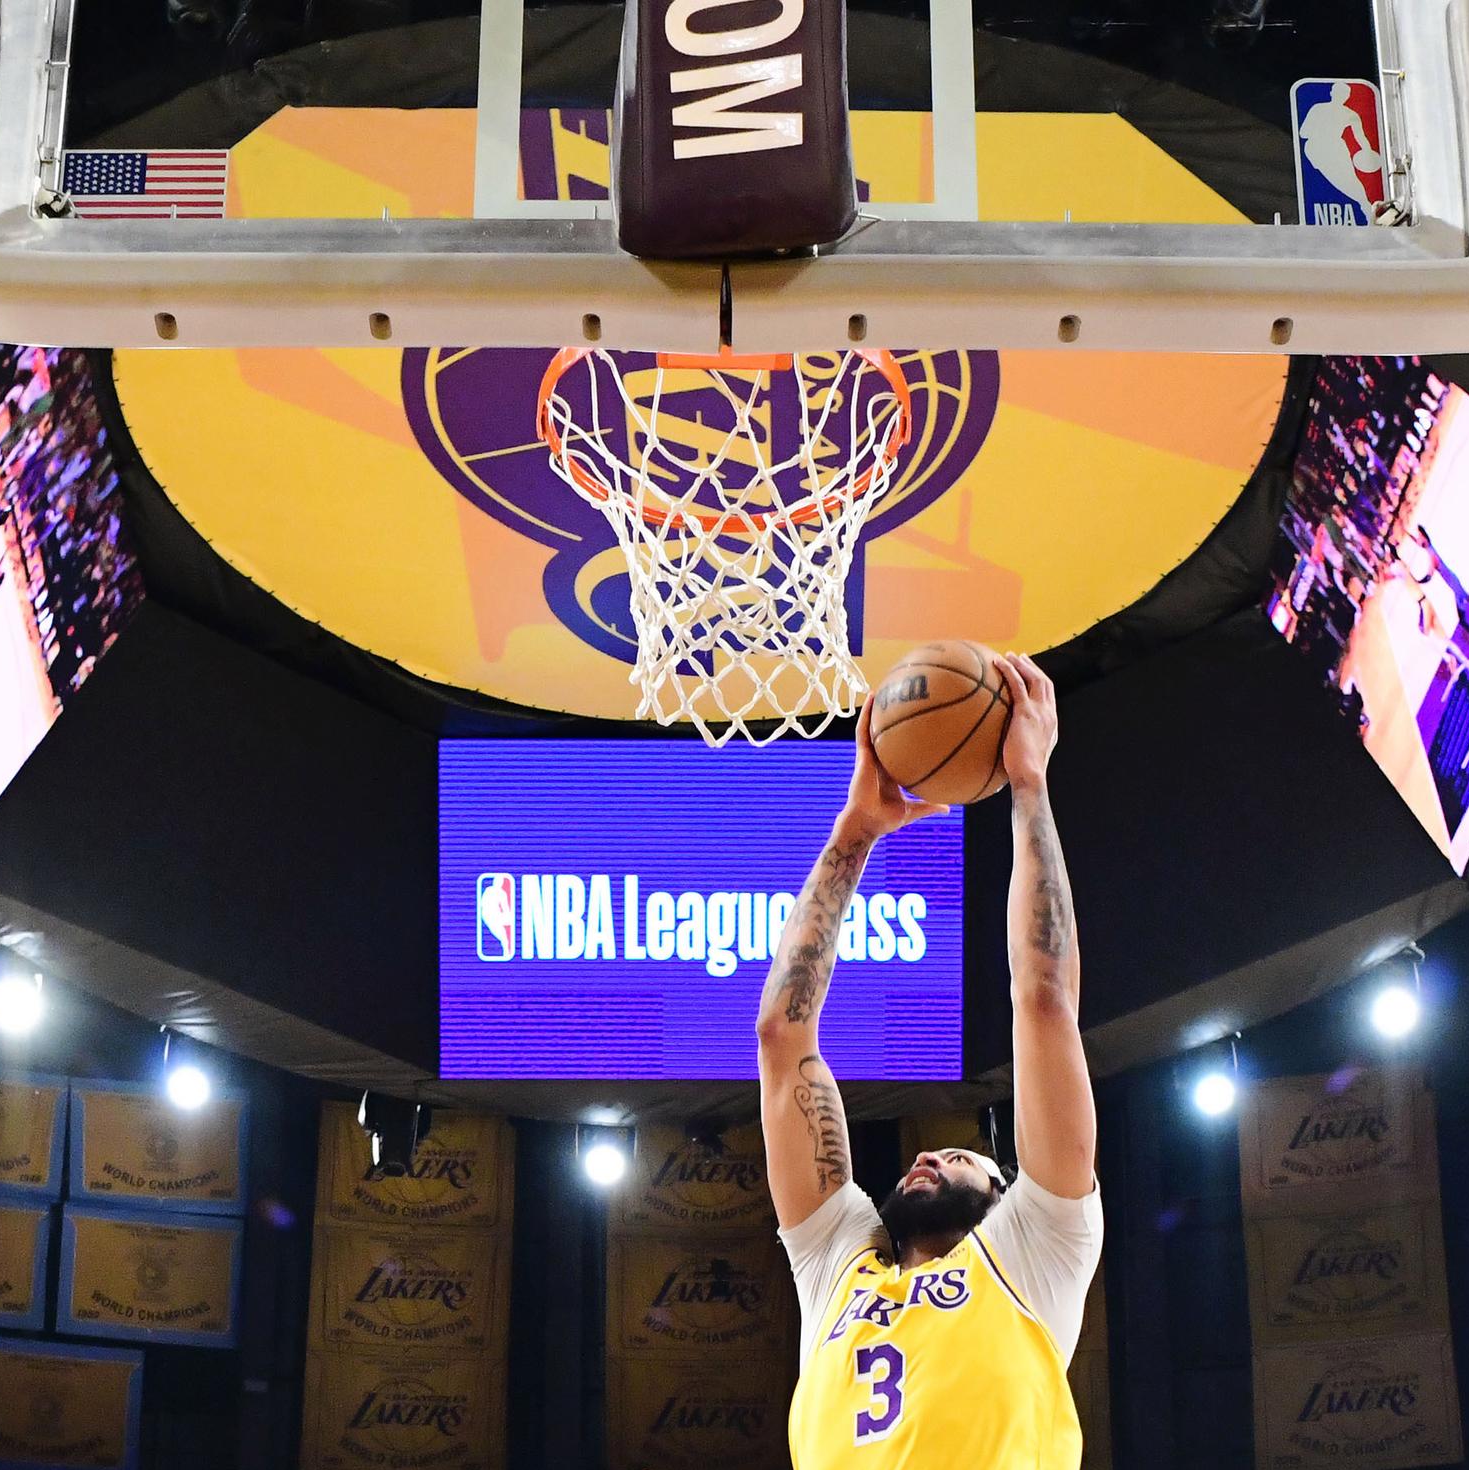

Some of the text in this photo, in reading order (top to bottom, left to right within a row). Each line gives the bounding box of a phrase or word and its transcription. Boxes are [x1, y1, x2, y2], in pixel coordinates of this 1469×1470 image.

[1314, 202, 1357, 226] NBA
[521, 874, 927, 977] NBA League ass
[649, 1152, 761, 1193] LAKERS
[91, 1290, 211, 1322] WORLD CHAMPIONS
[354, 1266, 470, 1310] LAKERS
[823, 1269, 970, 1348] LAKRS
[349, 1392, 468, 1438] LAKERS
[854, 1342, 906, 1447] 3
[1298, 1382, 1417, 1423] LAKERS
